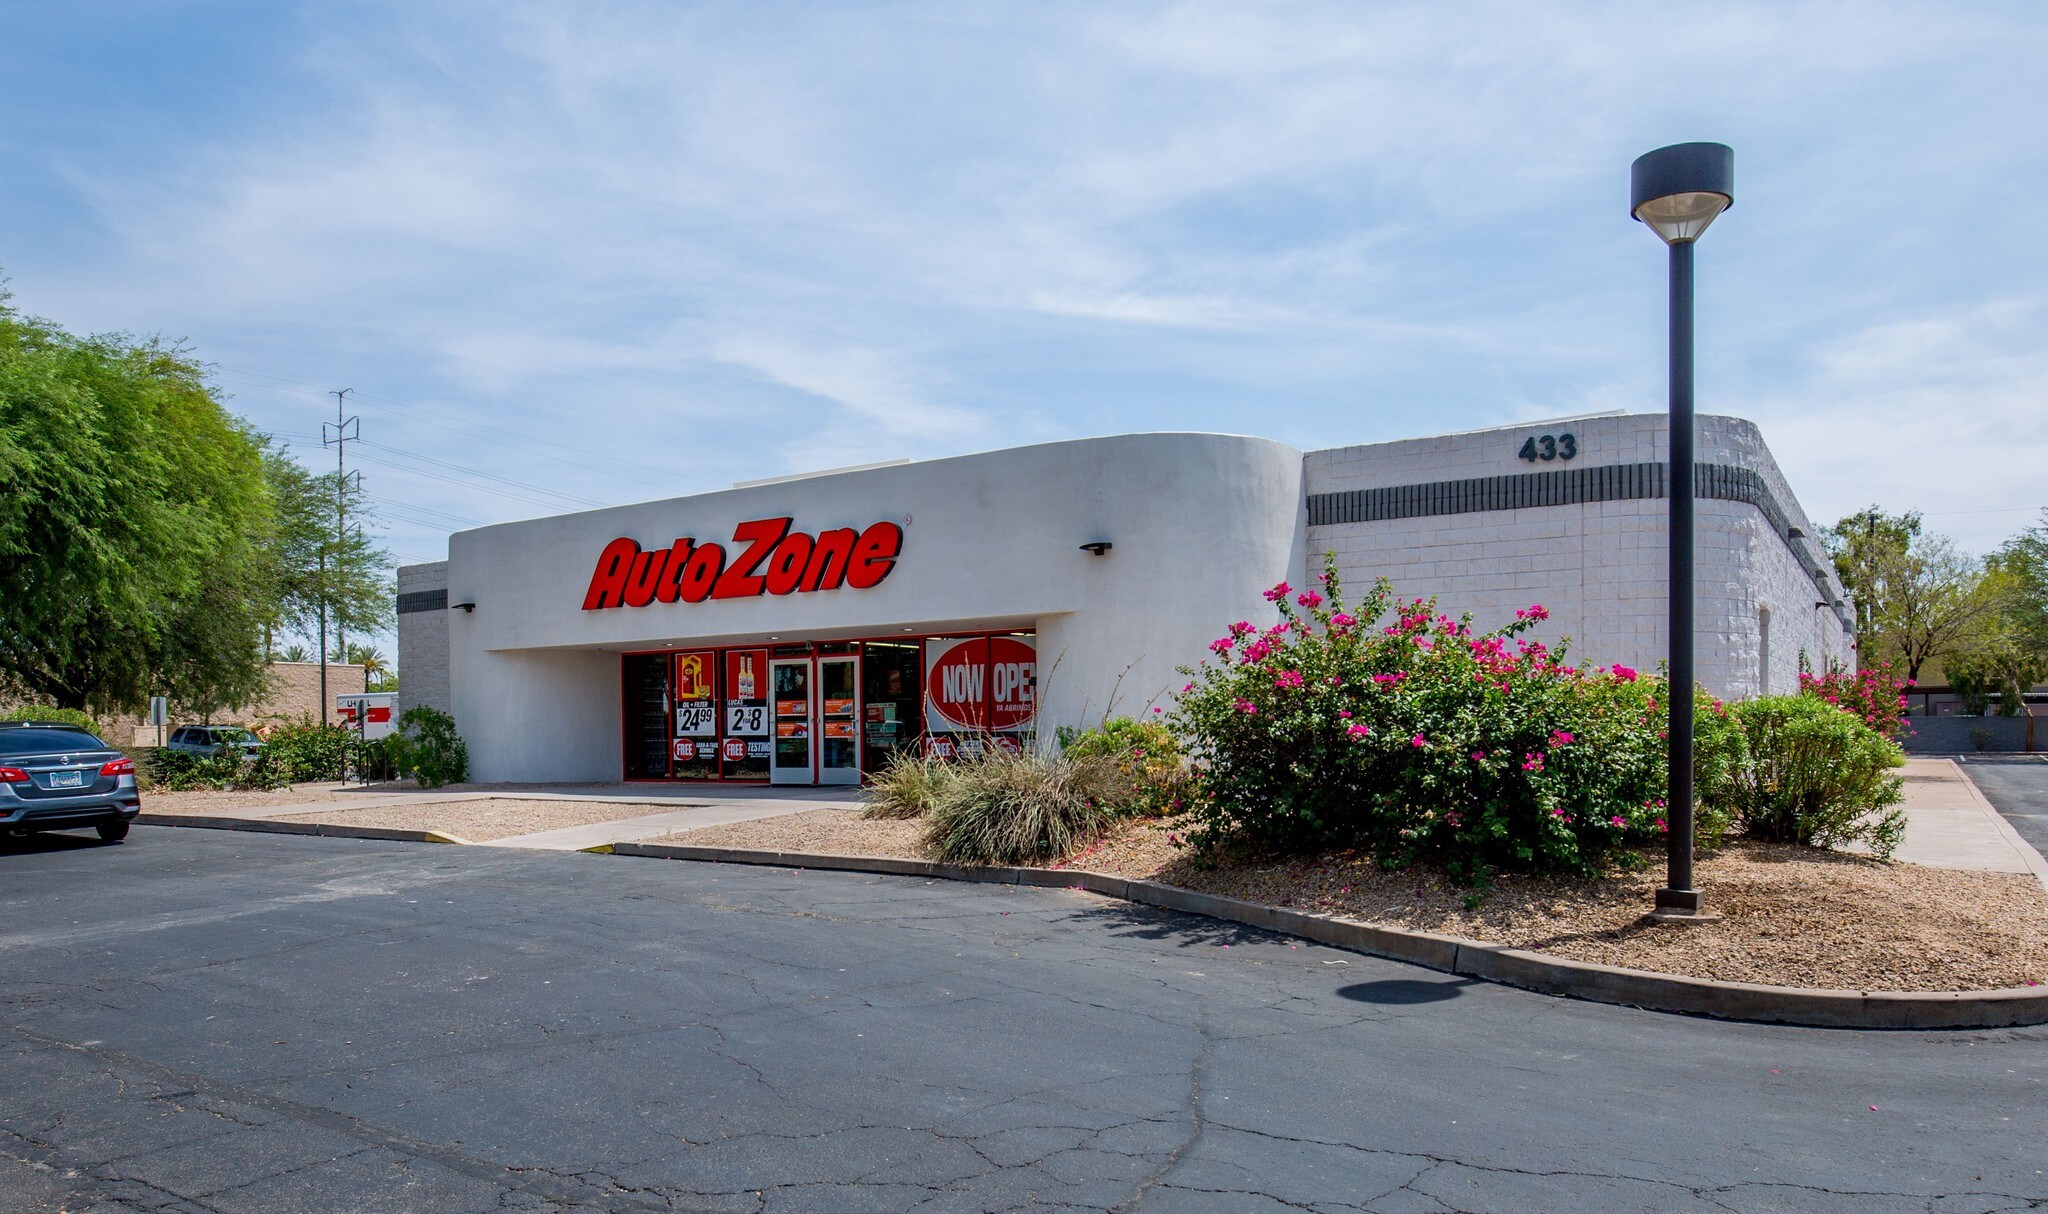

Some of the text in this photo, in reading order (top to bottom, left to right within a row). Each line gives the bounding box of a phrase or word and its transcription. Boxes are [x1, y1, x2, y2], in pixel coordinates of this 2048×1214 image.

[1518, 433, 1577, 462] 433
[581, 516, 904, 610] AutoZone
[942, 663, 985, 703] NOW
[732, 708, 744, 731] 2
[676, 743, 693, 756] FREE
[726, 743, 744, 756] FREE
